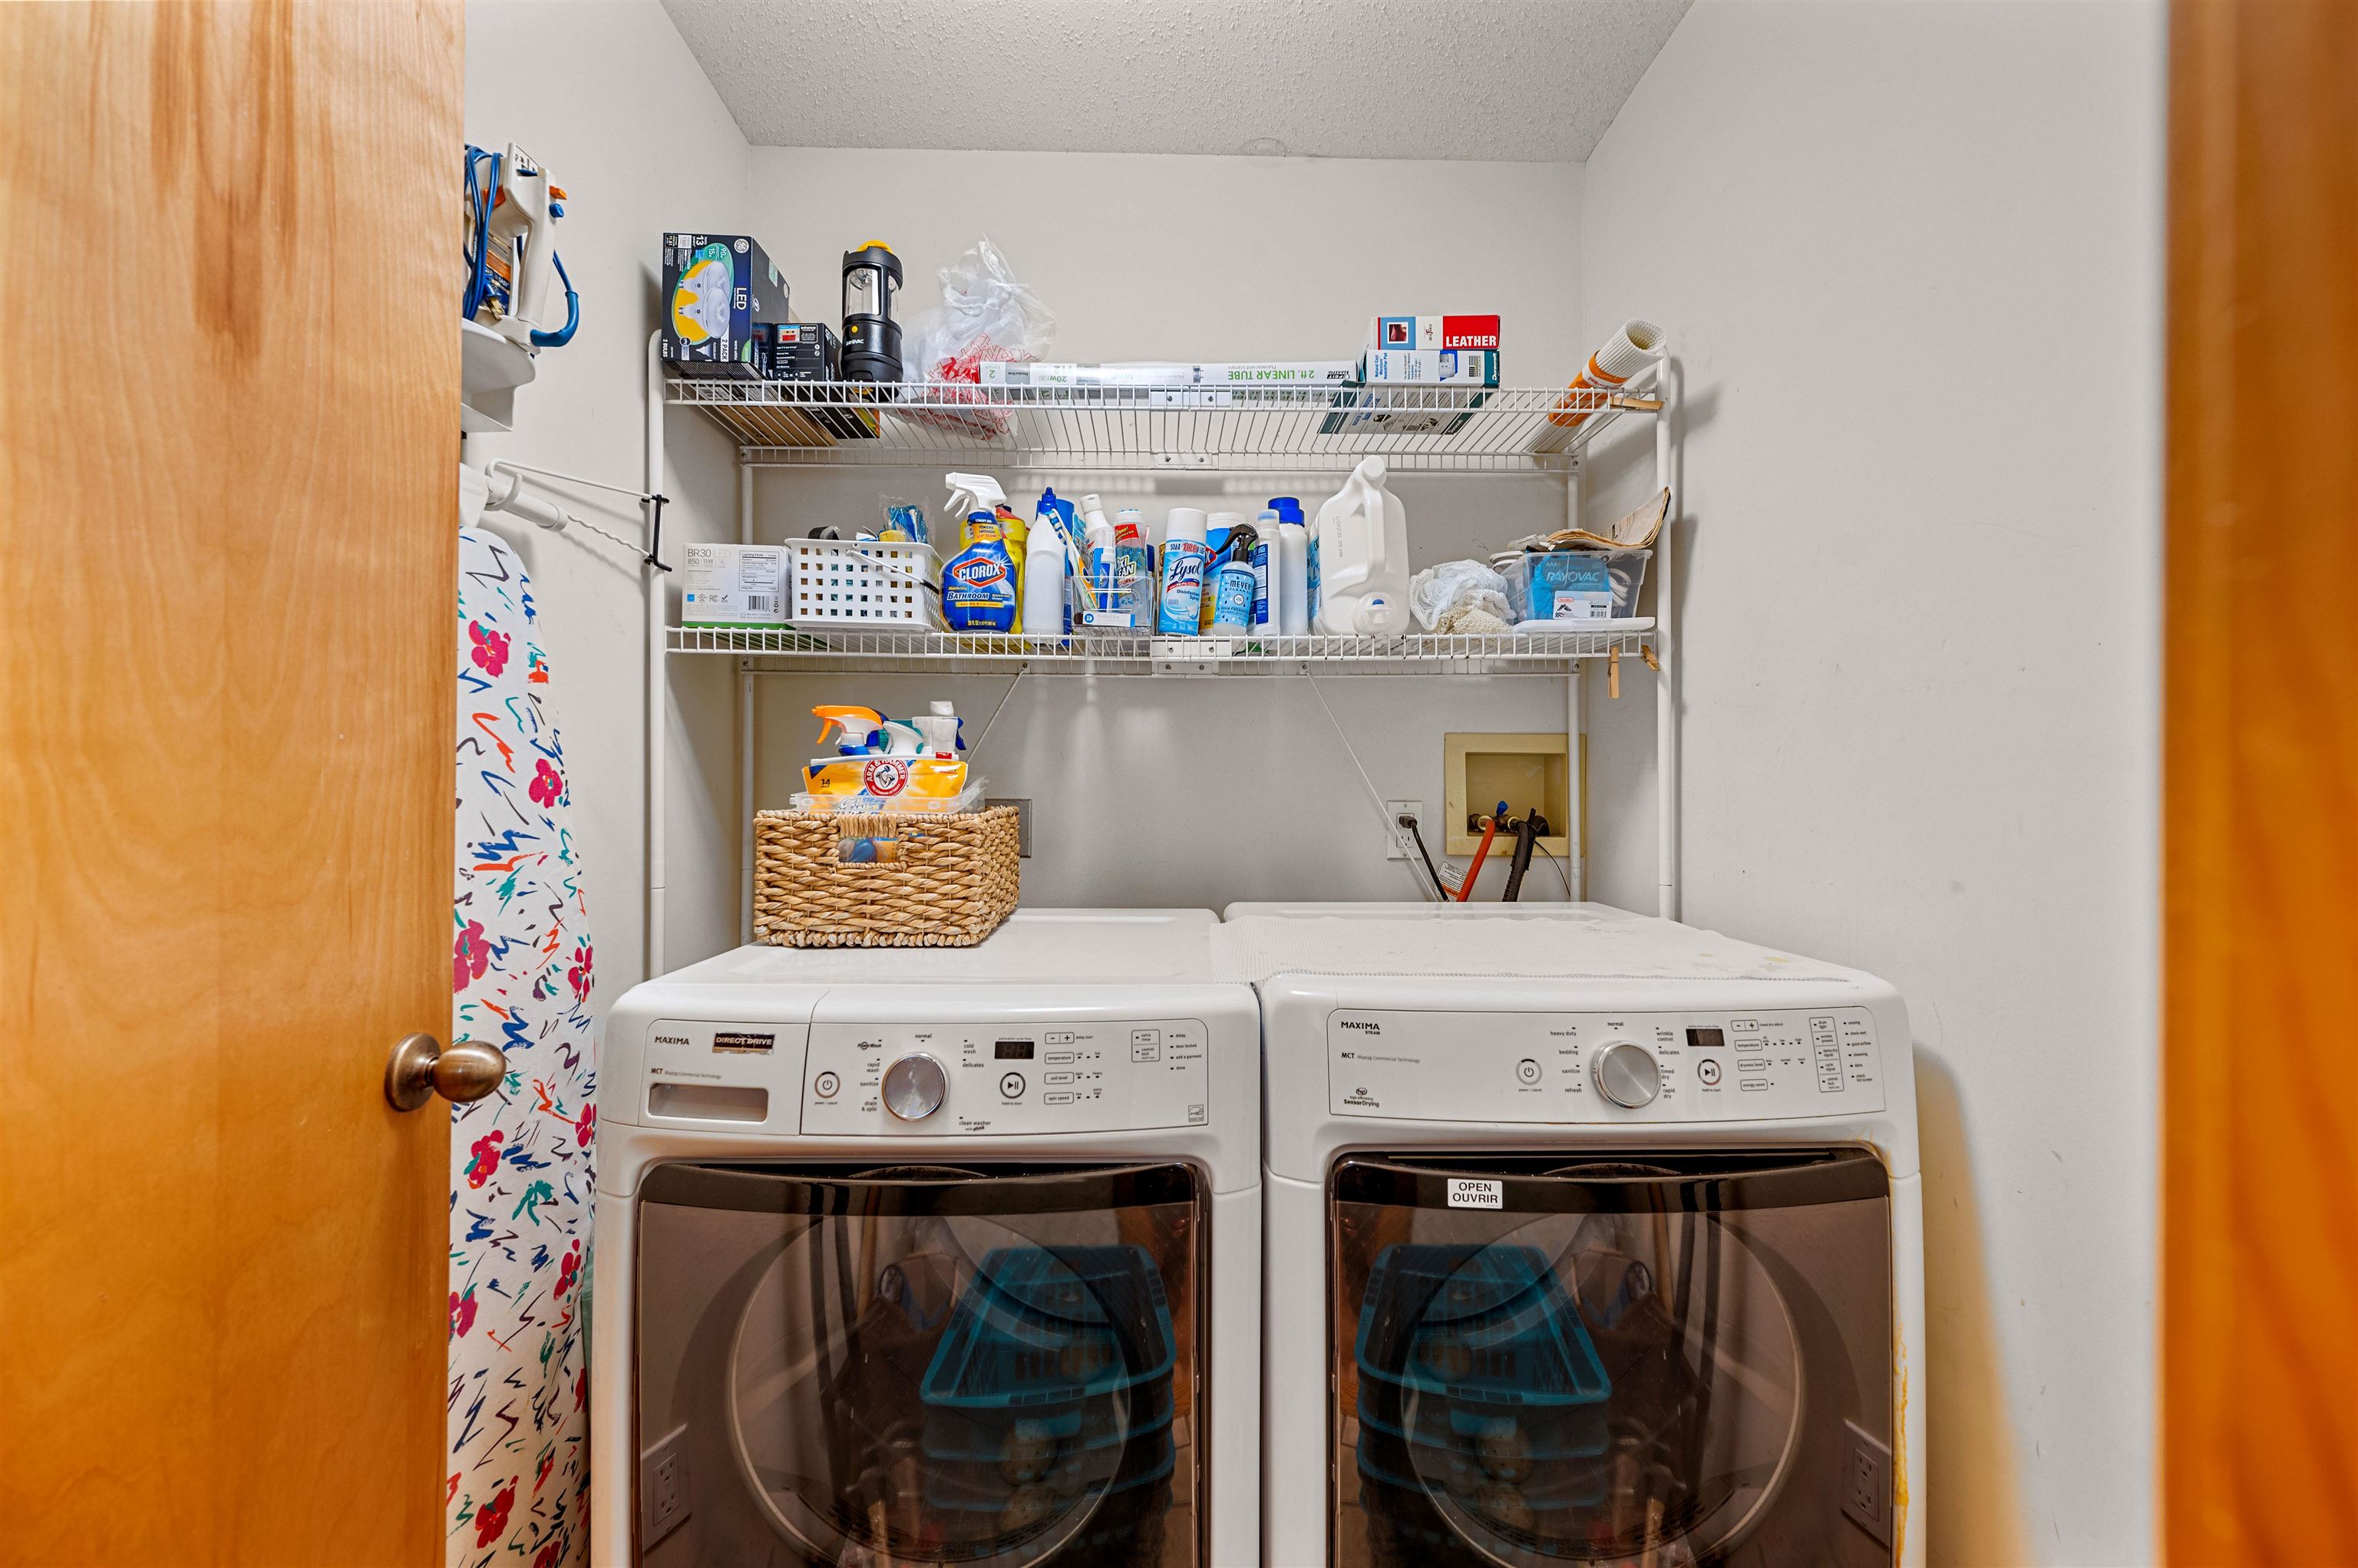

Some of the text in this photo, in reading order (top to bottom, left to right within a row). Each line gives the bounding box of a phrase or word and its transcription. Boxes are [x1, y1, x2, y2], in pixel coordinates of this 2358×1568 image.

[696, 236, 704, 246] 13
[737, 287, 747, 310] LED
[1446, 335, 1497, 347] LEATHER
[989, 369, 996, 378] 2
[1228, 371, 1253, 381] TUBE
[1257, 370, 1295, 380] LINEAR
[1308, 370, 1315, 379] 2
[688, 548, 712, 558] BR30
[959, 563, 1002, 581] CLOROX
[1169, 560, 1201, 581] Lysol
[1546, 572, 1600, 582] RAYOVAC
[947, 592, 989, 600] BATHROOM
[867, 764, 876, 781] ARM
[1341, 1022, 1380, 1030] MAXIMA
[654, 1036, 690, 1045] MAXIMA
[1343, 1098, 1379, 1108] SensorDrying
[1458, 1182, 1491, 1192] OPEN
[1453, 1193, 1498, 1203] OUVRIR
